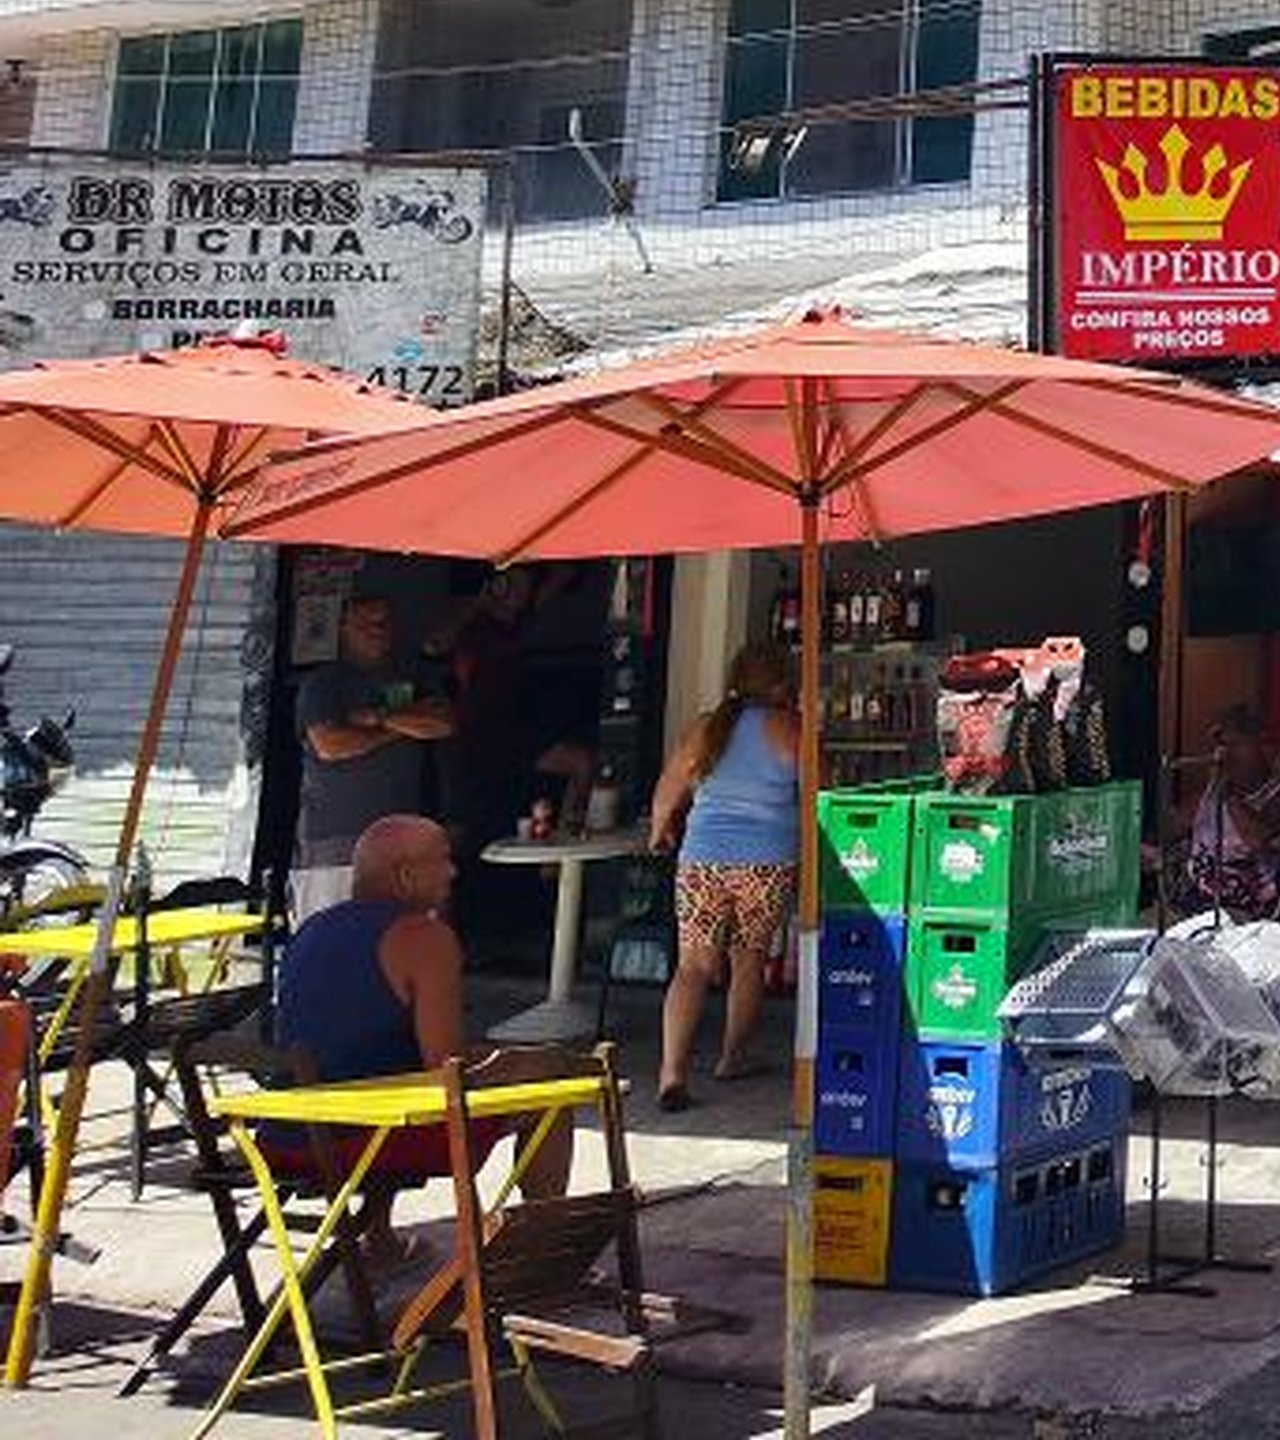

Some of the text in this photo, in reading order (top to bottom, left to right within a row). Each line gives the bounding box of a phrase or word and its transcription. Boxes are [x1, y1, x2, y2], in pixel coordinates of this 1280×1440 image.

[1071, 77, 1280, 119] BEBIDAS
[66, 175, 364, 227] DR MOTOS
[58, 227, 365, 256] OFICINA
[11, 261, 400, 290] SERVIÇOS EM GERAL
[1080, 243, 1280, 286] IMPÉRIO
[111, 298, 337, 320] BORRACHARIA
[1070, 306, 1270, 330] CONFIRA NOSSOS
[1133, 328, 1224, 351] PREÇOS
